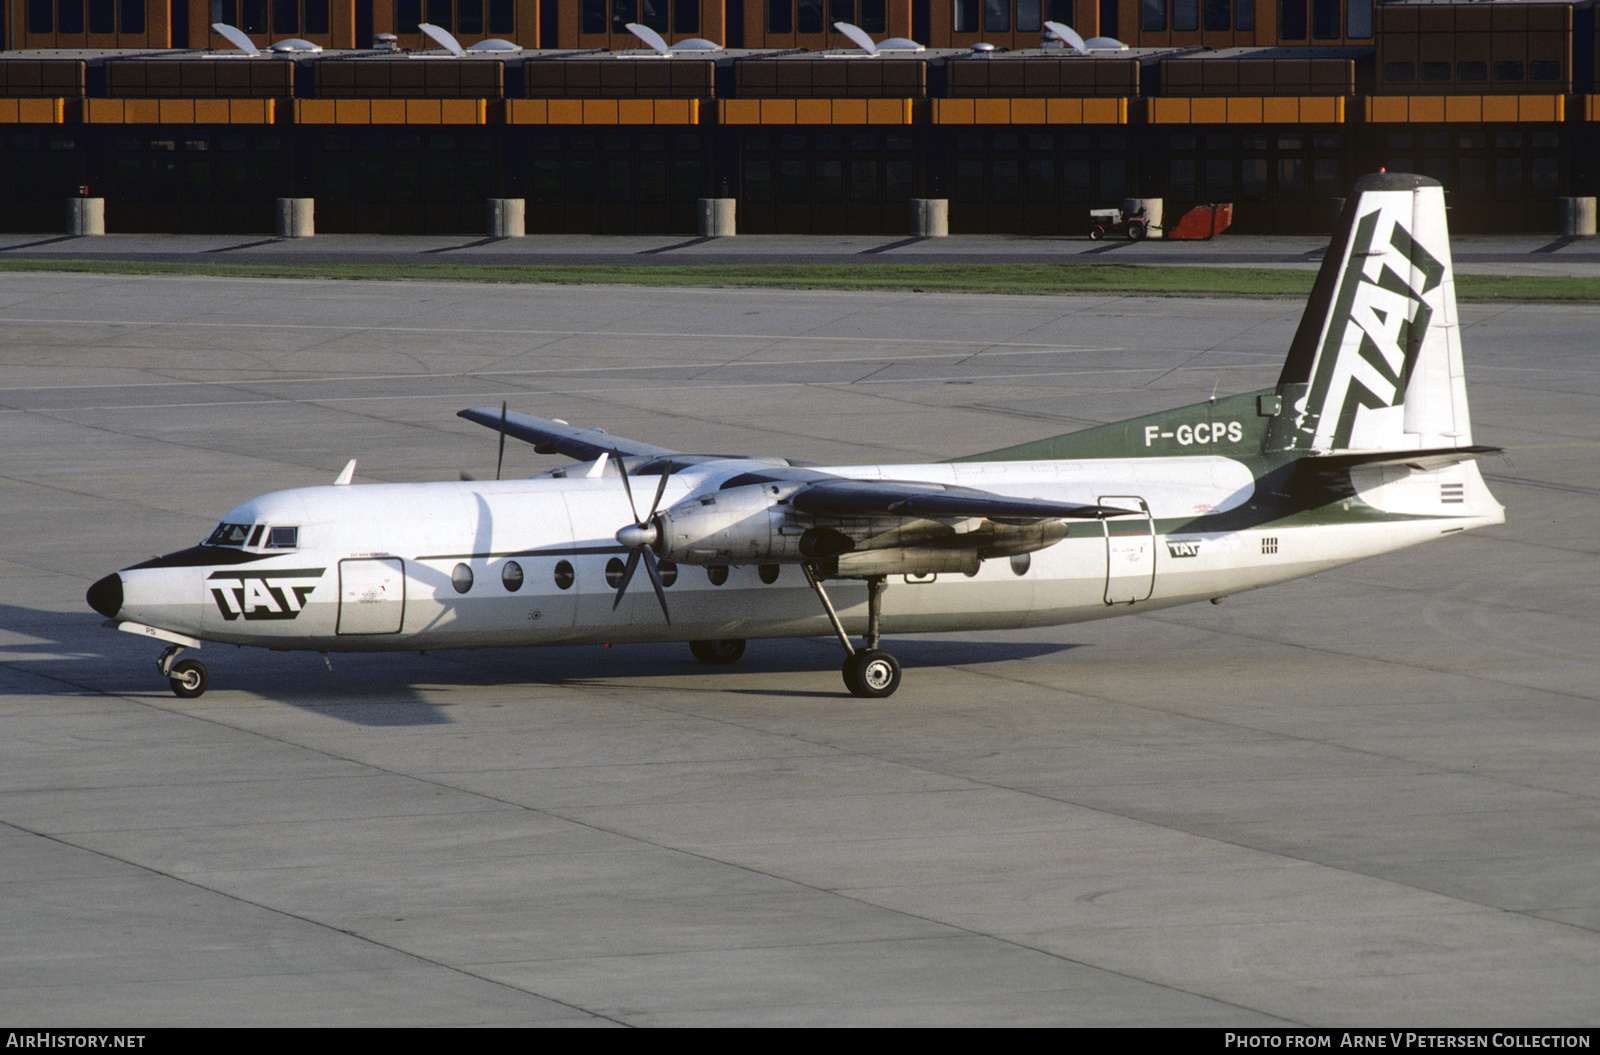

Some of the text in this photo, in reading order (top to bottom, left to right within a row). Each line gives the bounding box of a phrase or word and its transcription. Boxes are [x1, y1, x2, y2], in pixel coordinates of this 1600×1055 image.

[1309, 207, 1441, 450] TAT
[1144, 421, 1243, 447] F-GCPS
[1166, 540, 1201, 558] TAT
[207, 570, 324, 620] TAT
